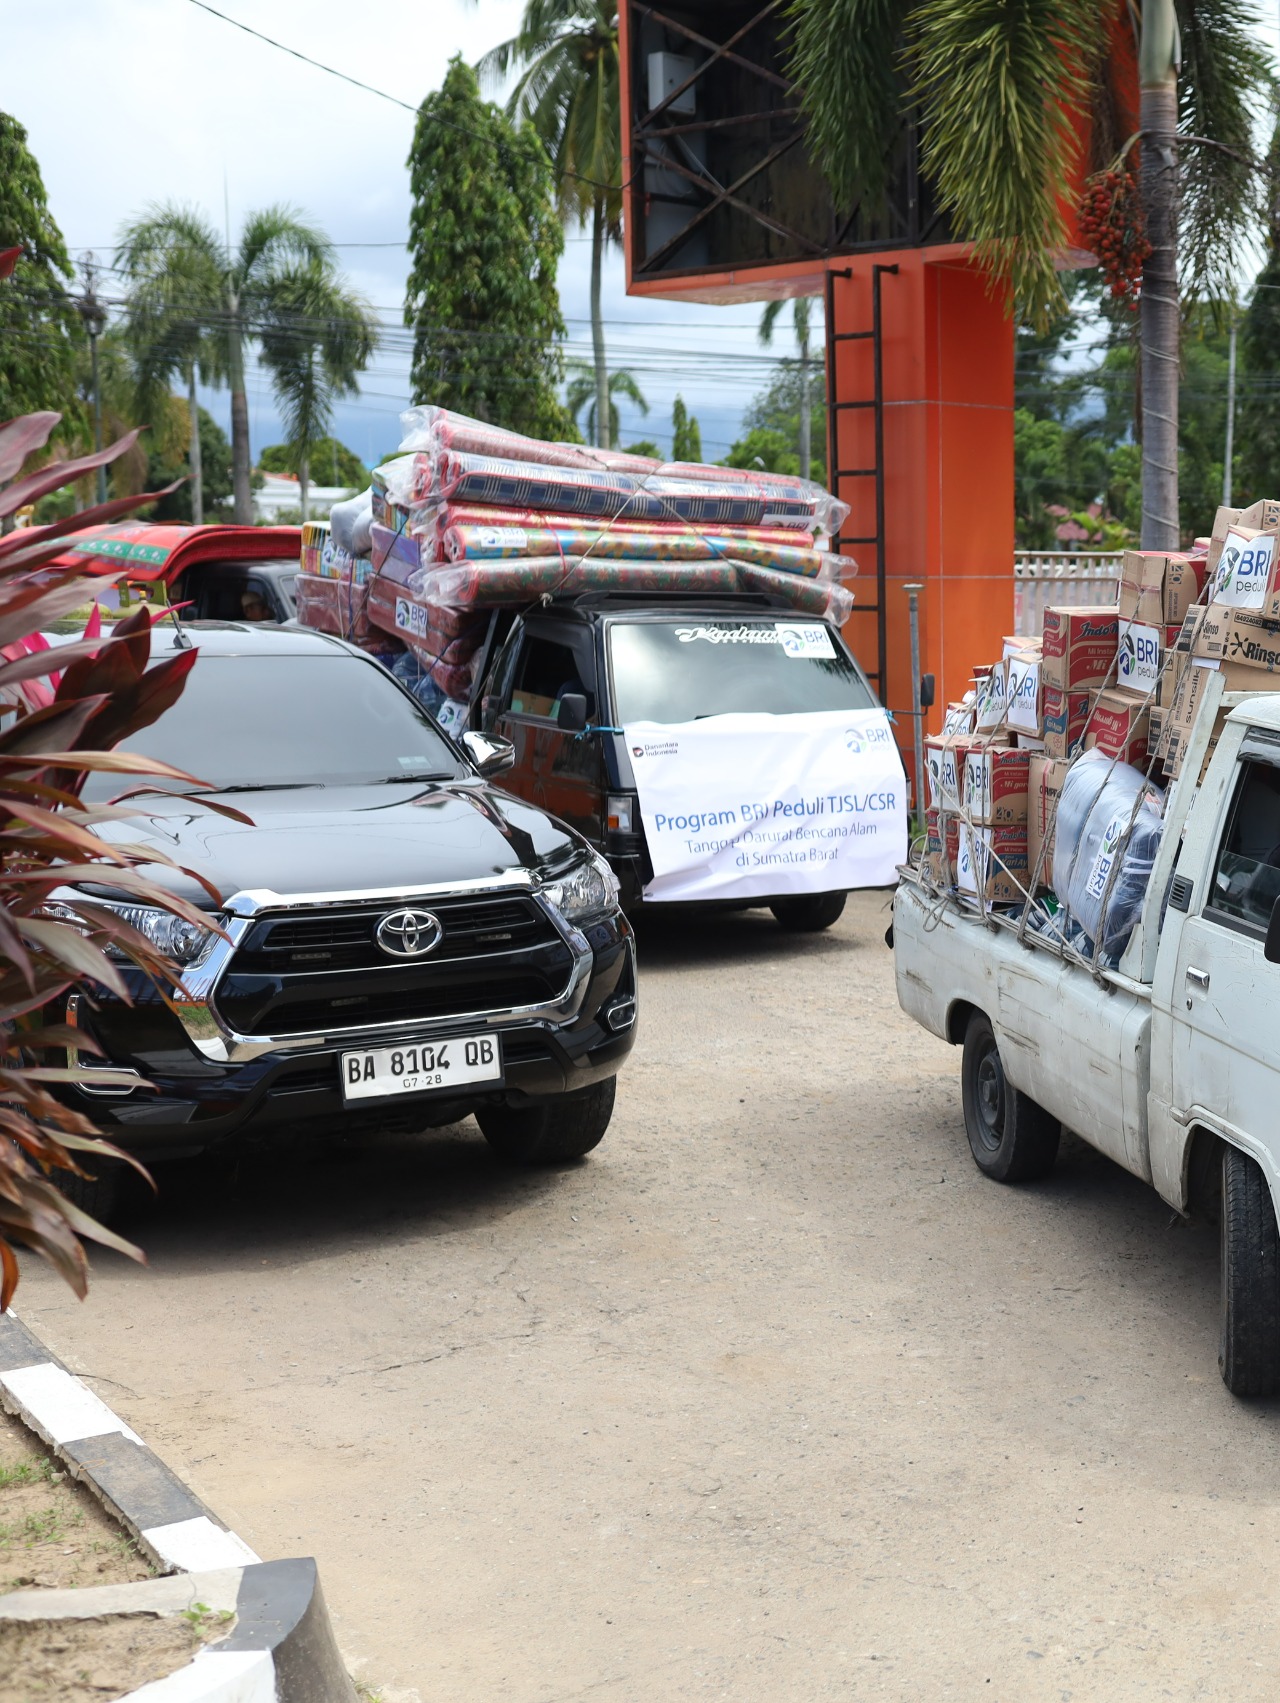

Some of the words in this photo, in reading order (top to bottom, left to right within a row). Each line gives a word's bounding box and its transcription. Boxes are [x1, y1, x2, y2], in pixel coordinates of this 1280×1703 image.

[1237, 549, 1271, 577] BRI
[411, 604, 428, 625] BRI
[804, 630, 829, 643] BRI
[1096, 647, 1116, 655] Insta
[1137, 637, 1158, 666] BRI
[1185, 669, 1201, 724] sunsilk
[866, 728, 890, 742] BRI
[654, 809, 736, 833] Program
[772, 796, 824, 818] Peduli
[826, 792, 896, 814] TJSL/CSR
[795, 826, 848, 841] Bencana
[849, 821, 877, 836] Alam
[735, 852, 750, 867] di
[752, 850, 806, 866] Sumatra
[809, 847, 838, 861] Barat
[1094, 857, 1112, 896] BRI
[348, 1055, 376, 1084] BA
[390, 1044, 451, 1076] 8104
[464, 1039, 494, 1066] QB
